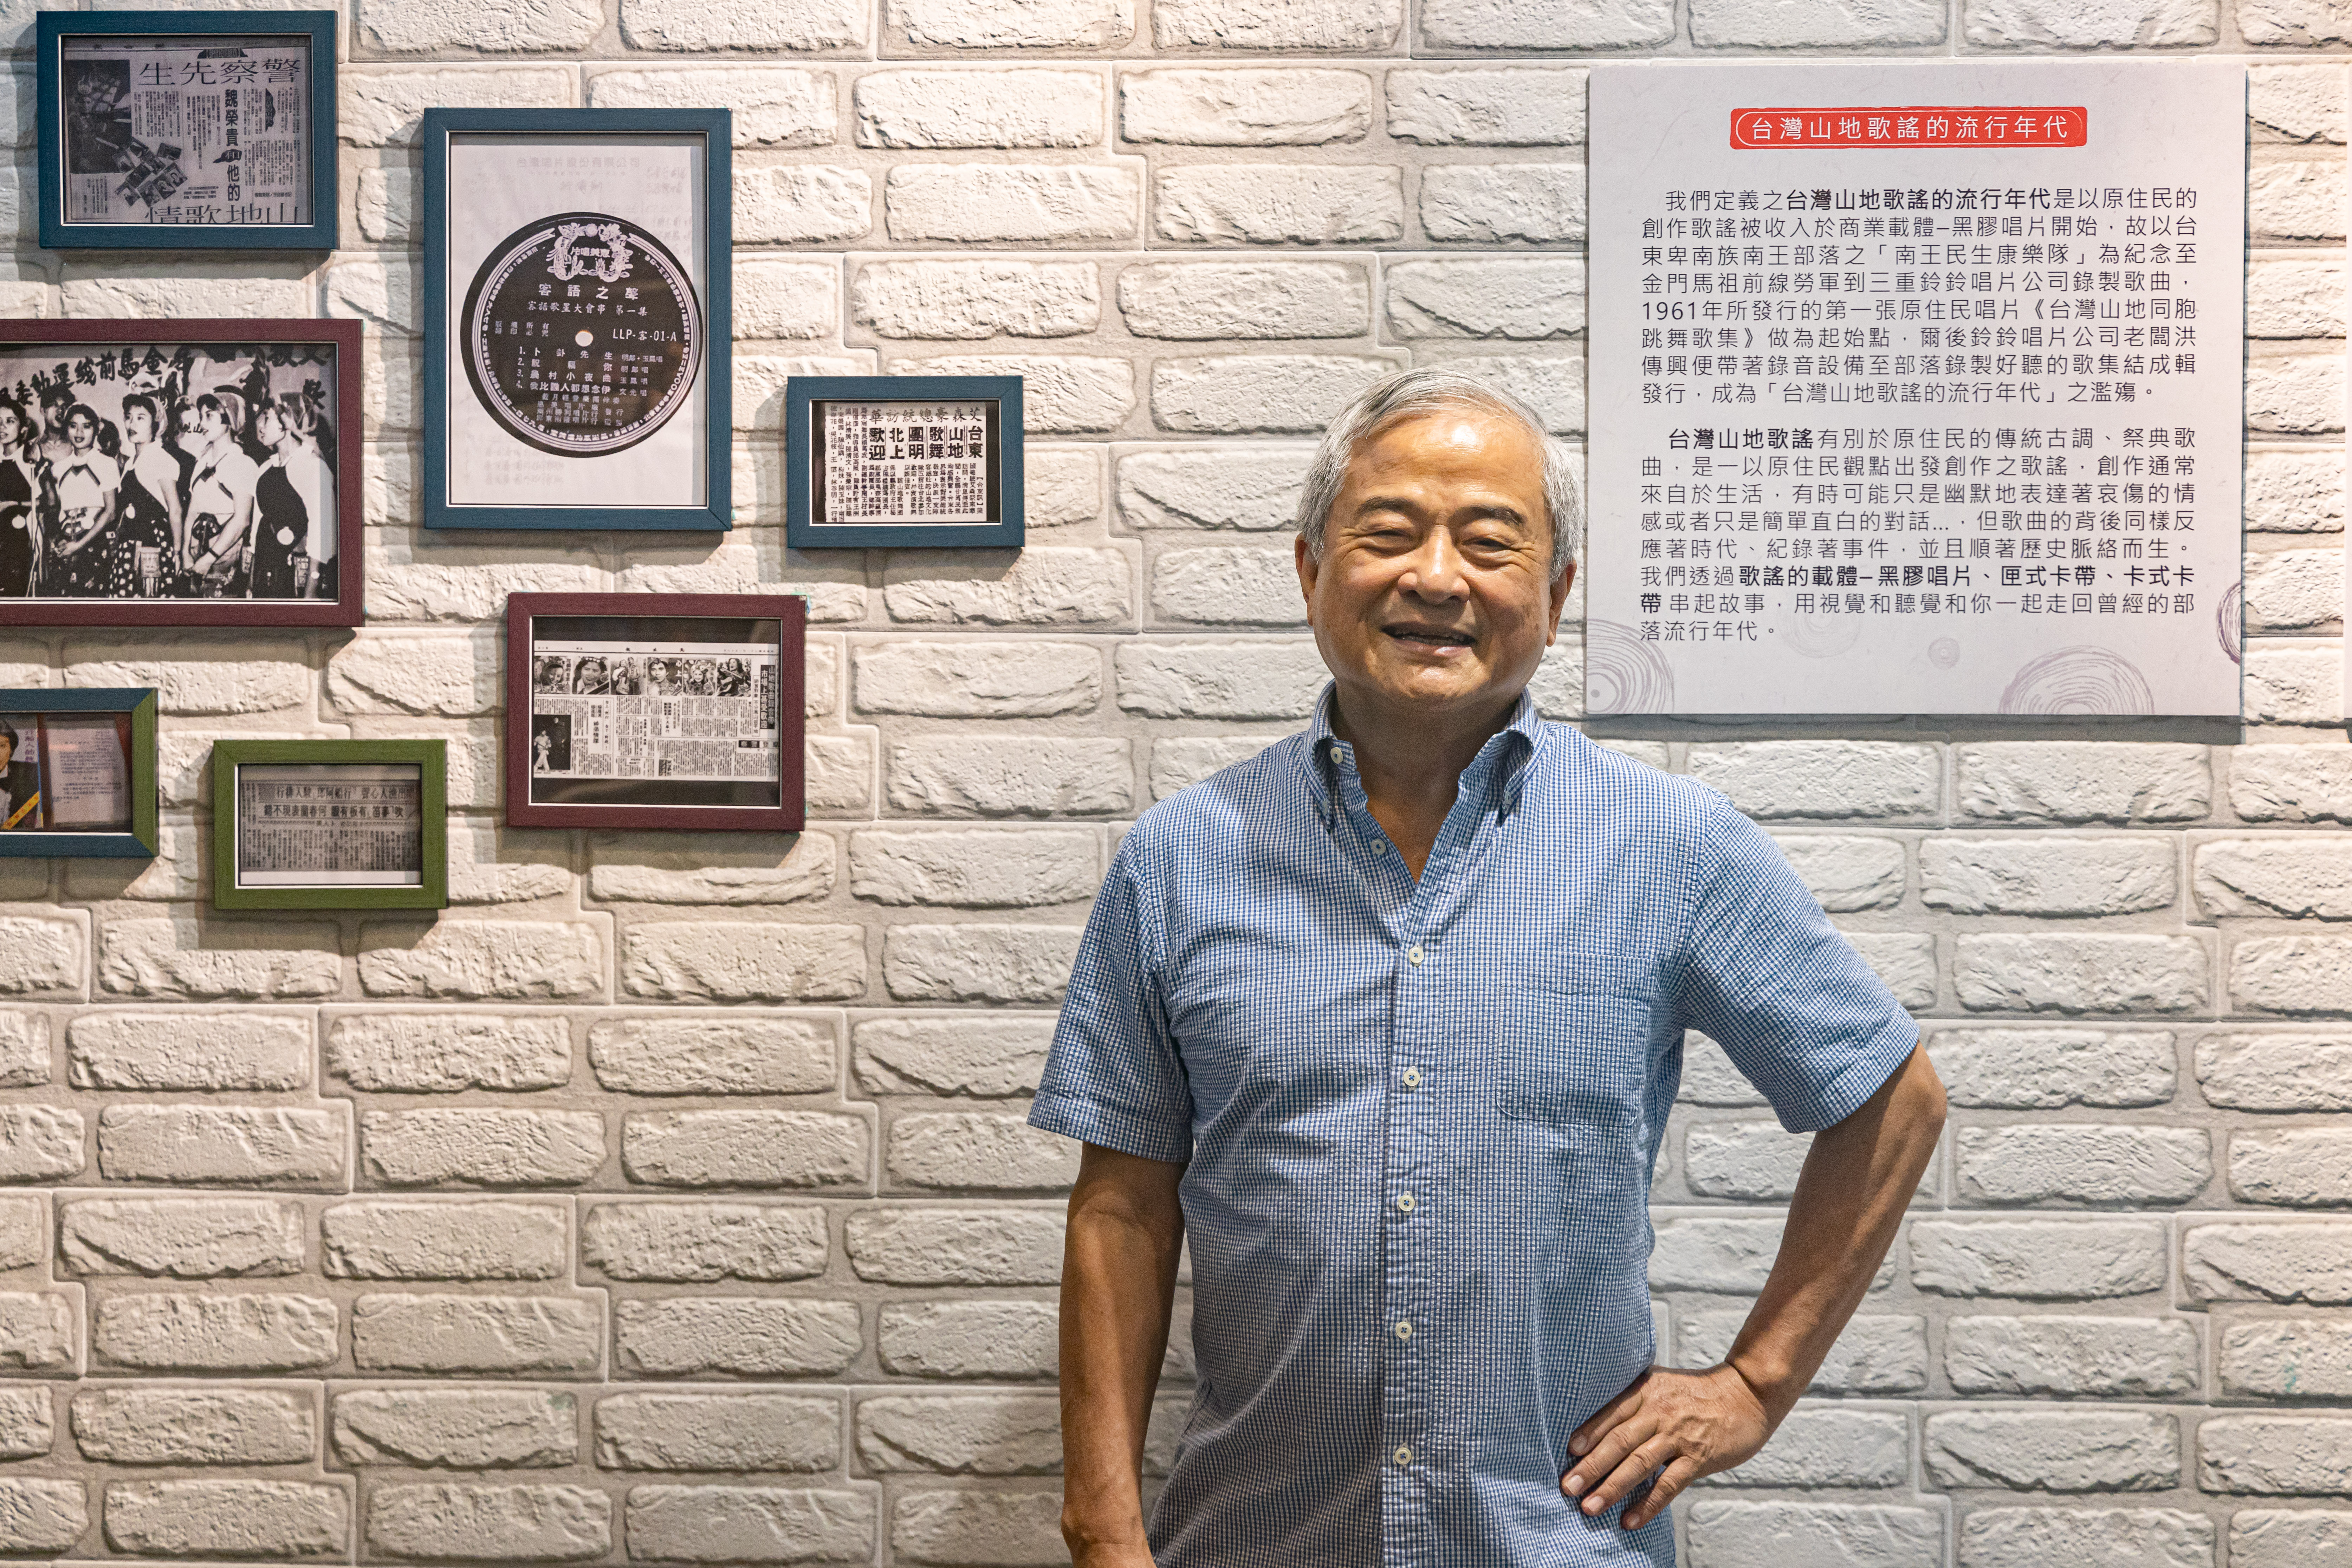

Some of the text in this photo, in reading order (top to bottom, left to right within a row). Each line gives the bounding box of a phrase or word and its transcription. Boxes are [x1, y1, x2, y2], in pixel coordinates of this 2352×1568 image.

[138, 58, 300, 85] 警察先生
[1752, 115, 2067, 140] 台灣山地歌謠的流行年代
[225, 89, 241, 201] 魏榮貴和他的
[1666, 188, 2196, 211] 我們定義之台灣山地歌謠的流行年代是以原住民的
[1642, 244, 2196, 266] 東卑南族南王部落之「南王民生康樂隊」為紀念至
[1642, 271, 2188, 293] 金門馬祖前線勞軍到三重鈴鈴唱片公司錄製歌曲，
[1643, 298, 2196, 321] 1961年所發行的第一張原住民唱片《台灣山地同胞
[613, 329, 677, 342] LLP-客-01-A
[1642, 326, 2196, 349] 跳舞歌集》做為起始點，爾後鈴鈴唱片公司老闆洪
[519, 346, 525, 355] 1.
[517, 369, 523, 377] 3.
[518, 358, 524, 366] 2.
[1642, 354, 2195, 376] 傳興便帶著錄音設備至部落錄製好聽的歌集結成輯
[1642, 382, 2152, 404] 發行，成為「台灣山地歌謠的流行年代」之濫殤。
[869, 407, 982, 424] 艾森豪總統訪華
[868, 427, 885, 460] 歡迎
[889, 427, 905, 460] 北上
[908, 426, 924, 460] 團明
[929, 426, 944, 459] 歌舞
[948, 426, 964, 459] 山地
[968, 425, 984, 458] 台東
[1669, 427, 2195, 449] 台灣山地歌謠有別於原住民的傳統古調、祭典歌
[1643, 455, 2194, 477] 曲，是一以原住民觀點出發創作之歌謠，創作通常
[1641, 483, 2195, 504] 來自於生活，有時可能只是幽默地表達著哀傷的情
[1641, 538, 2186, 559] 應著時代、紀錄著事件，並且順著歷史脈絡而生。
[1640, 593, 2194, 614] 帶串起故事，用視覺和聽覺和你一起走回曾經的部
[1641, 621, 1774, 641] 落流行年代。
